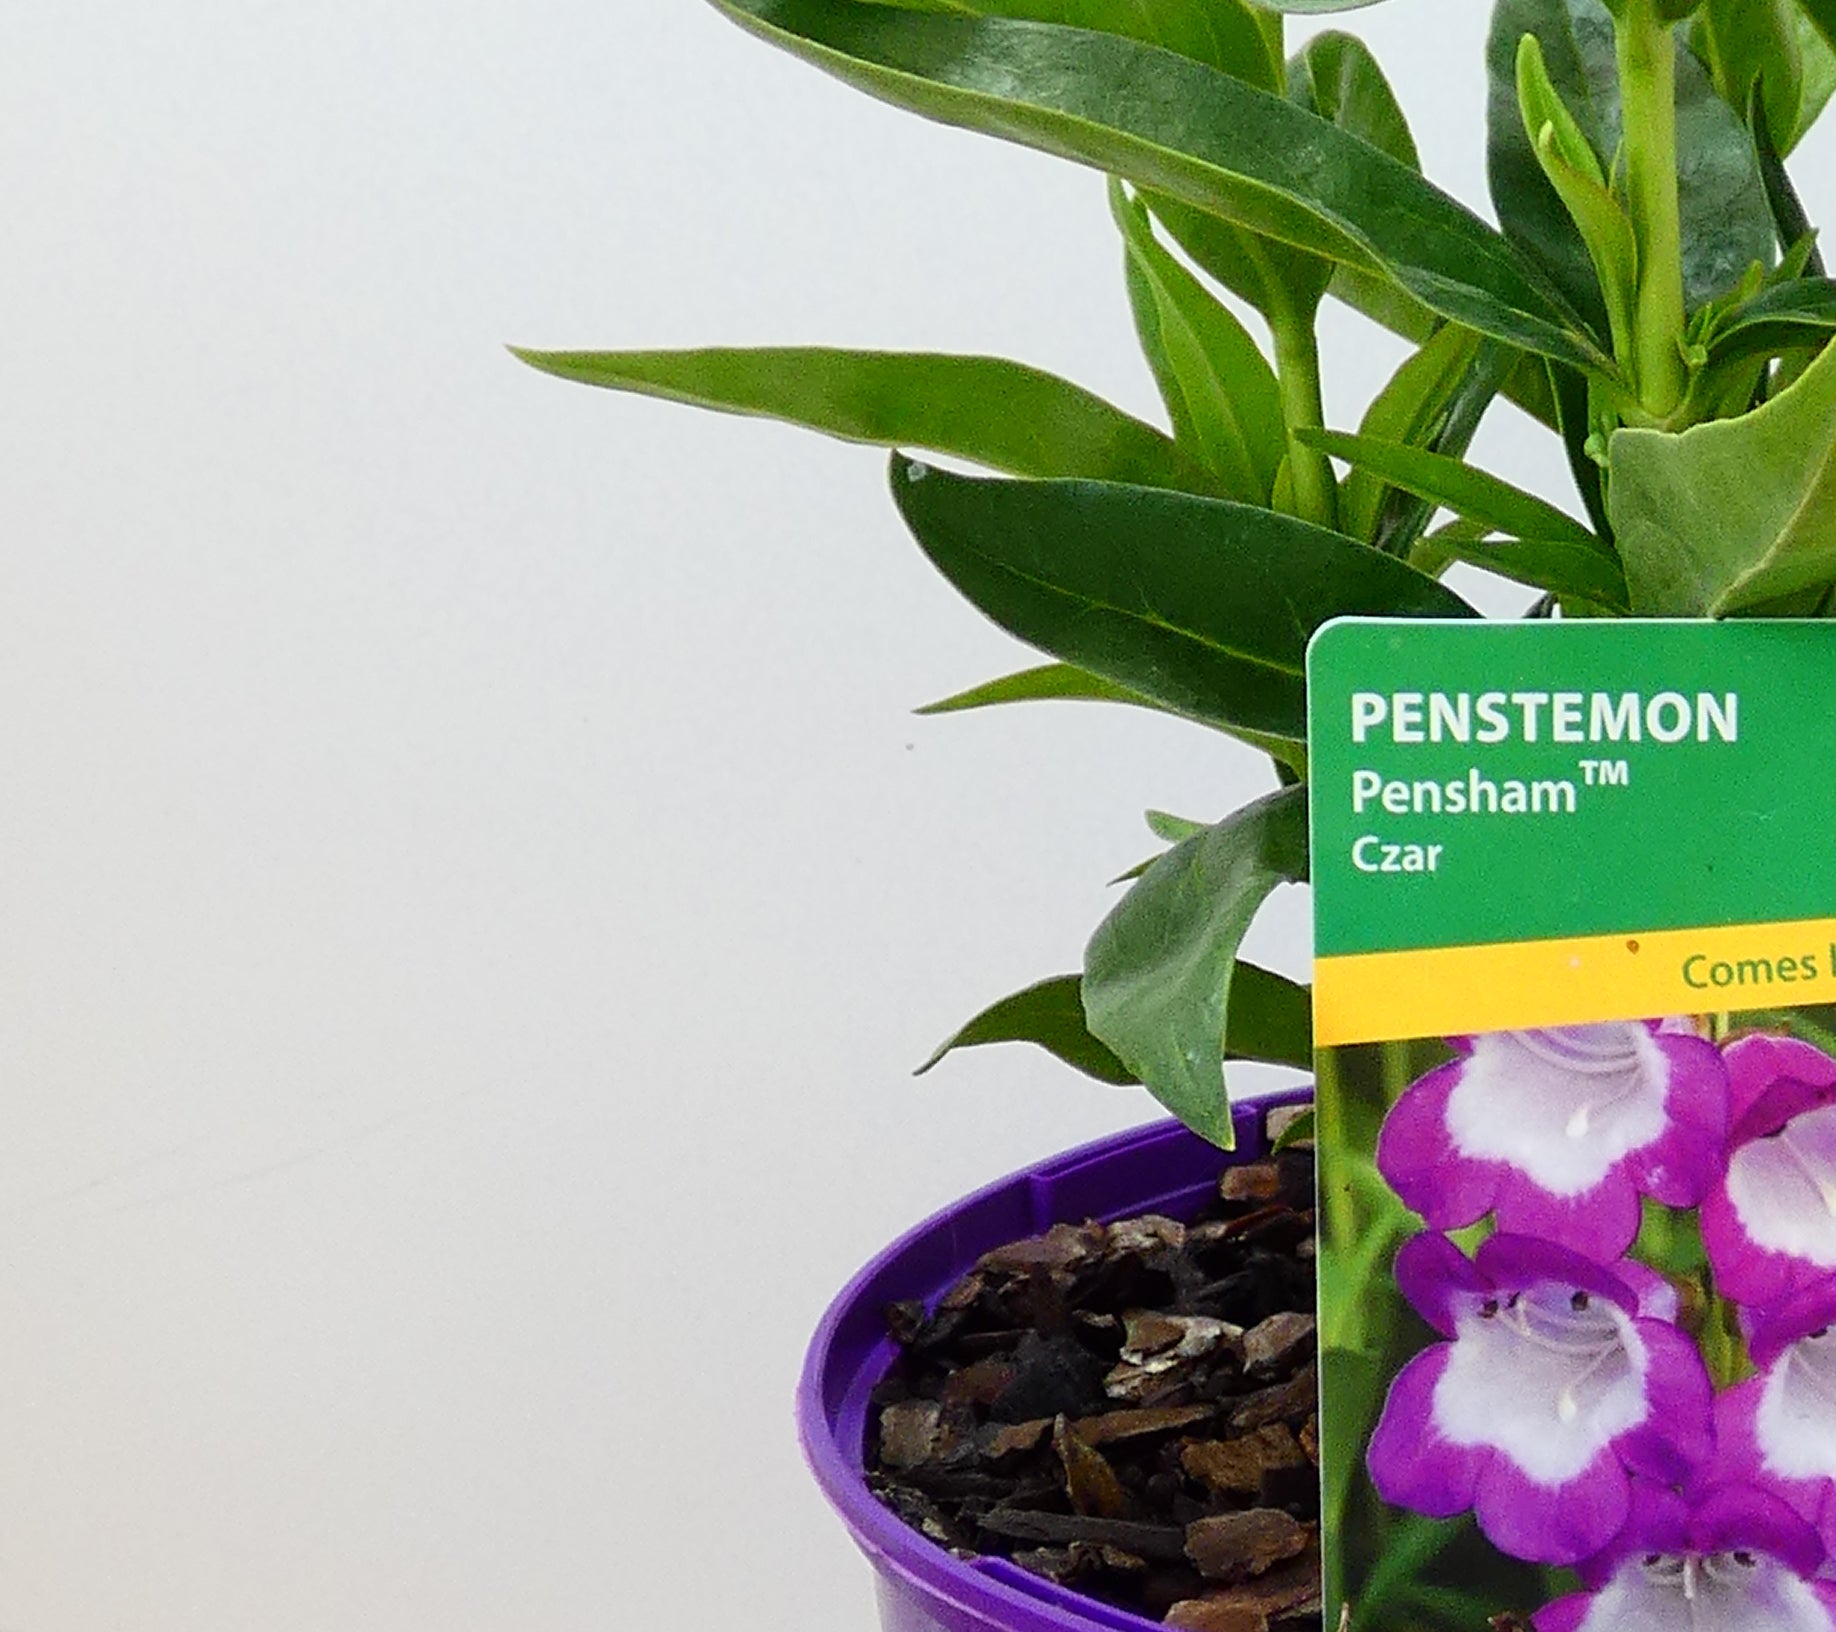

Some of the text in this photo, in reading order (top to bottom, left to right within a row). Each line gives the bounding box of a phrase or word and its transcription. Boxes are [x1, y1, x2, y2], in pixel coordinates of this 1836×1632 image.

[1351, 690, 1739, 745] PENSTEMON
[1351, 837, 1442, 872] Czar
[1682, 950, 1818, 990] Comes
